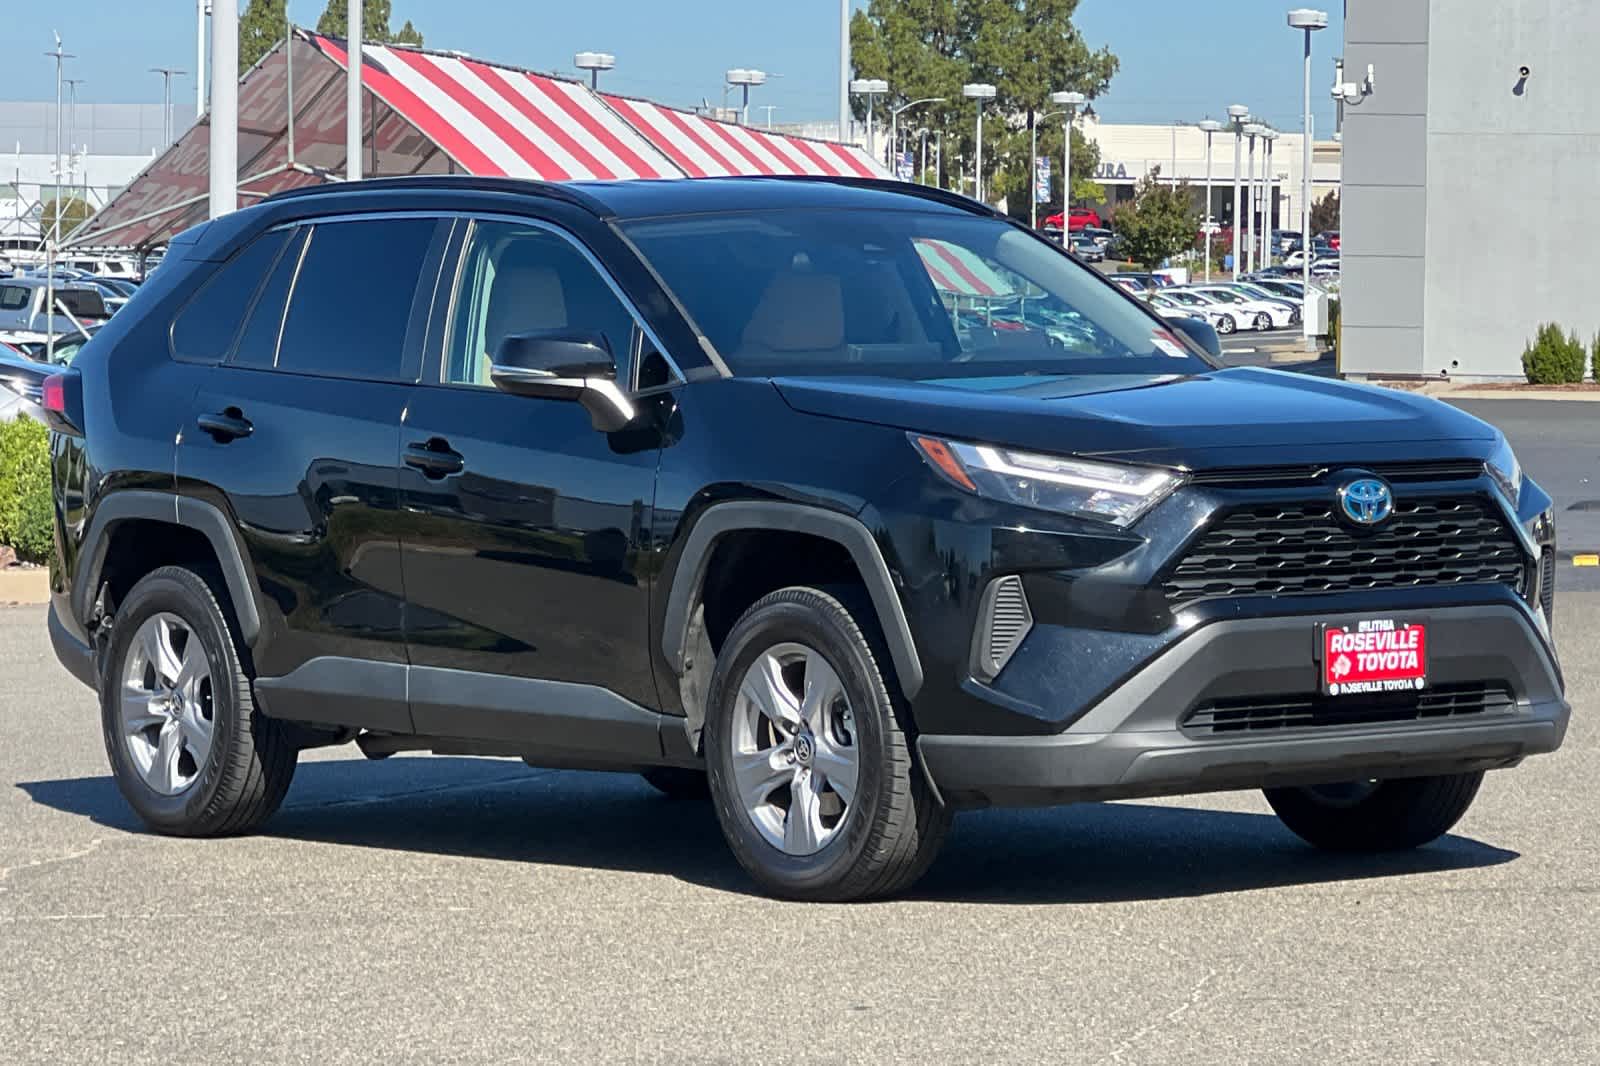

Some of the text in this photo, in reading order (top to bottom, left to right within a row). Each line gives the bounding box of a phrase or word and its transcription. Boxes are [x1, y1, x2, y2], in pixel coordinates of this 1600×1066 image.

[1331, 630, 1418, 653] ROSEVILLE
[1357, 651, 1418, 672] TOYOTA
[1341, 680, 1413, 694] ROSEVILLE TOYOTA
